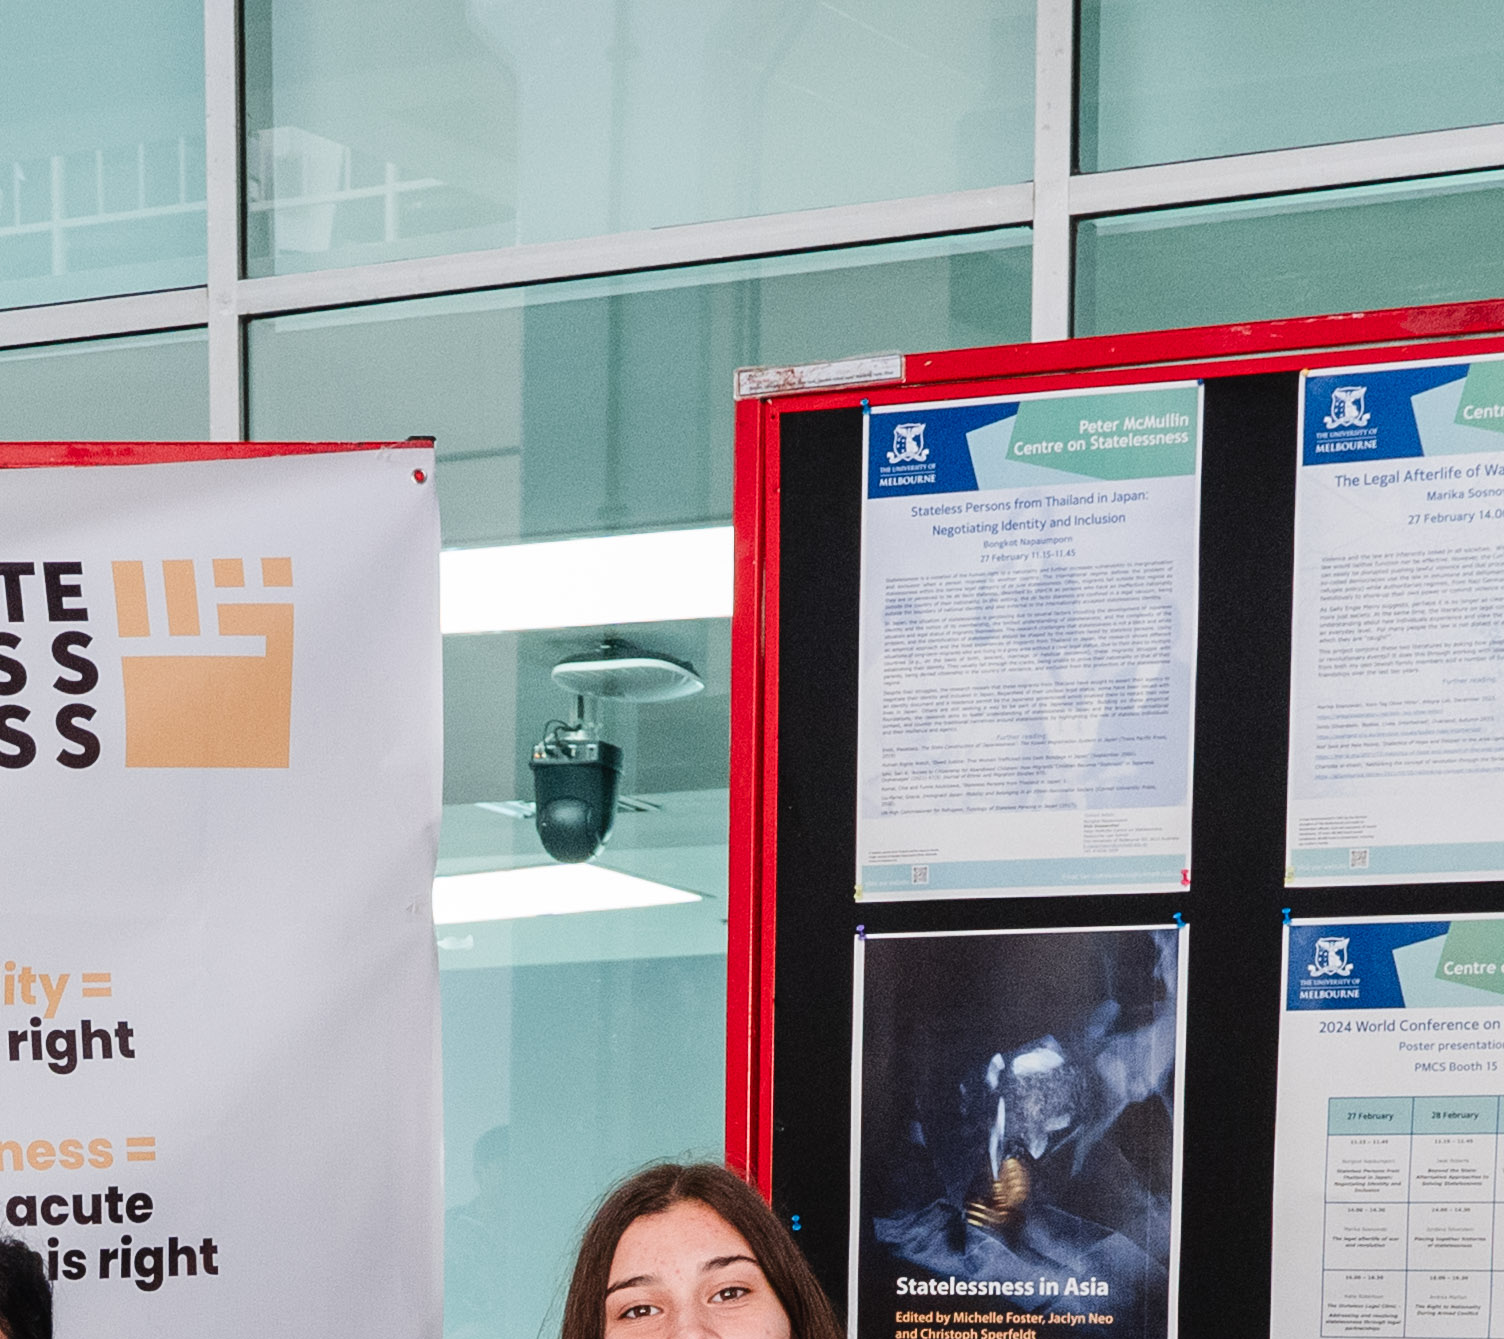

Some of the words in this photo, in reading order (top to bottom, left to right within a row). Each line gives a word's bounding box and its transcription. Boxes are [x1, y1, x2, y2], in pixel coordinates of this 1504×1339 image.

[1079, 419, 1119, 435] Peter
[1123, 413, 1189, 431] McMullin
[1014, 441, 1063, 456] Centre
[1067, 439, 1087, 452] on
[1090, 431, 1189, 450] Statelessness
[1315, 439, 1377, 453] MELBOURNE
[879, 474, 936, 487] MELBOURNE
[1335, 474, 1361, 488] The
[1364, 472, 1400, 489] Legal
[1403, 466, 1462, 482] Afterlife
[1466, 465, 1481, 478] of
[1426, 489, 1465, 501] Marika
[911, 504, 962, 518] Stateless
[965, 501, 1011, 513] Persons
[1014, 497, 1042, 509] from
[1045, 493, 1094, 507] Thailand
[1098, 492, 1108, 504] in
[1111, 490, 1148, 505] Japan:
[932, 521, 999, 537] Negotiating
[1001, 518, 1047, 532] Identity
[1049, 515, 1071, 527] and
[1074, 512, 1125, 525] Inclusion
[1408, 514, 1420, 525] 27
[1424, 510, 1475, 526] February
[981, 553, 991, 563] 27
[993, 550, 1029, 564] February
[1444, 961, 1497, 976] Centre
[82, 972, 112, 998] =
[1300, 988, 1360, 1000] MELBOURNE
[1319, 1022, 1352, 1033] 2024
[1355, 1019, 1395, 1033] World
[1399, 1018, 1479, 1032] Conference
[1483, 1020, 1501, 1030] on
[8, 1016, 135, 1075] right
[1399, 1041, 1435, 1051] Poster
[1414, 1062, 1446, 1072] PMCS
[1449, 1060, 1483, 1071] Booth
[1486, 1061, 1498, 1071] 15
[1347, 1112, 1356, 1120] 27
[1357, 1111, 1394, 1122] February
[1431, 1111, 1440, 1119] 28
[1442, 1110, 1479, 1122] February
[126, 1136, 157, 1162] =
[5, 1186, 154, 1228] acute
[98, 1235, 219, 1292] right
[896, 1276, 1034, 1295] Statelessness
[1039, 1277, 1059, 1295] in
[1064, 1277, 1109, 1296] Asia
[896, 1311, 933, 1323] Edited
[936, 1311, 950, 1325] by
[953, 1312, 1003, 1324] Michelle
[1006, 1312, 1045, 1325] Foster,
[1048, 1312, 1085, 1326] Jaclyn
[1088, 1313, 1114, 1324] Neo
[895, 1328, 918, 1339] and
